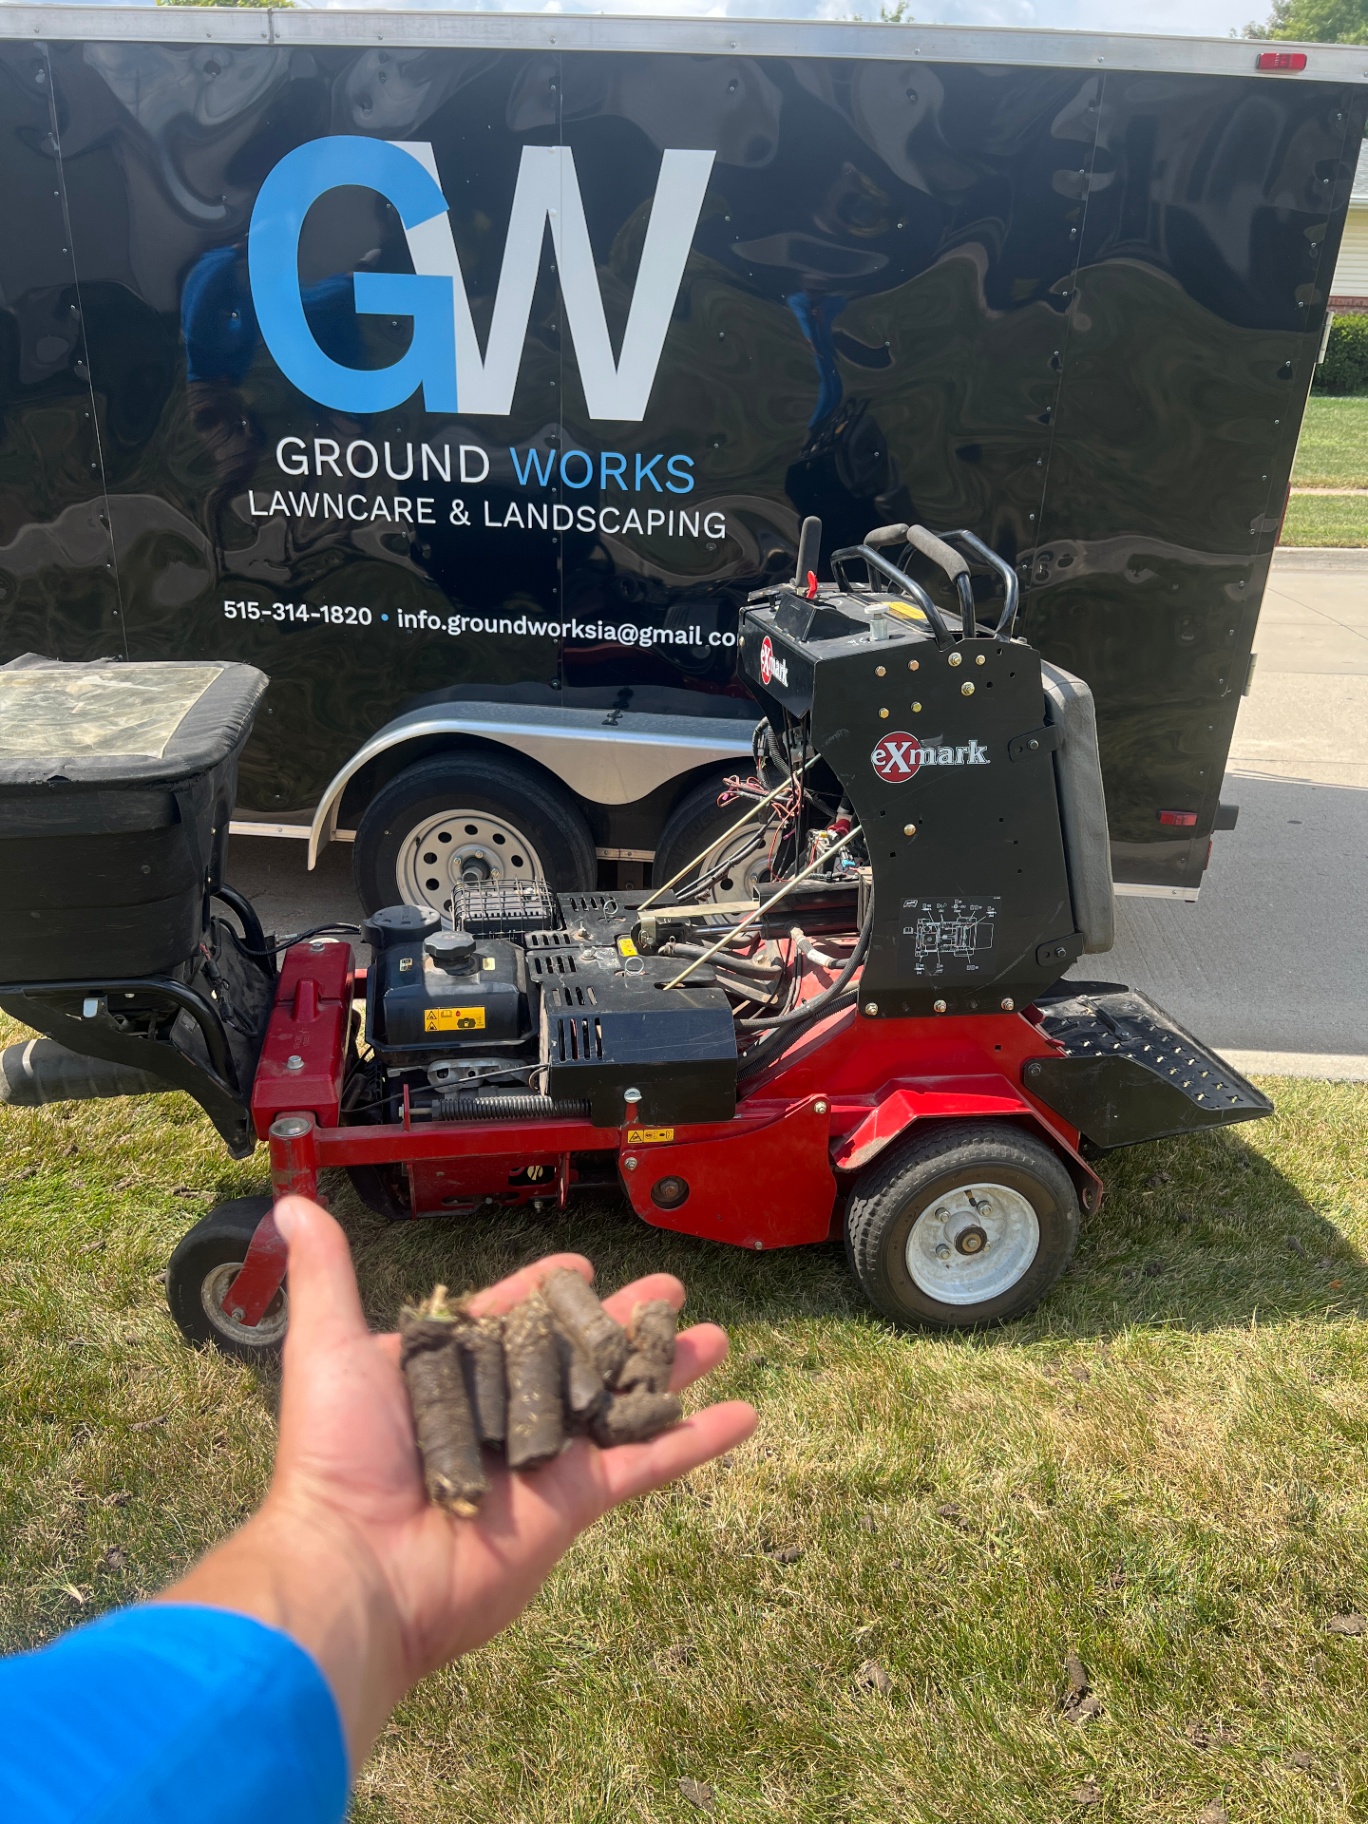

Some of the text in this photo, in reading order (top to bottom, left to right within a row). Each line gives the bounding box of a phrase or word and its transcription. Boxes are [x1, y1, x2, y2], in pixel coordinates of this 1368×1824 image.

[248, 135, 716, 421] GW
[276, 436, 696, 494] GROUND WORKS
[248, 489, 727, 539] LAWNCARE & LANDSCAPING
[223, 600, 373, 626] 515-314-1820
[871, 739, 990, 773] eXmark
